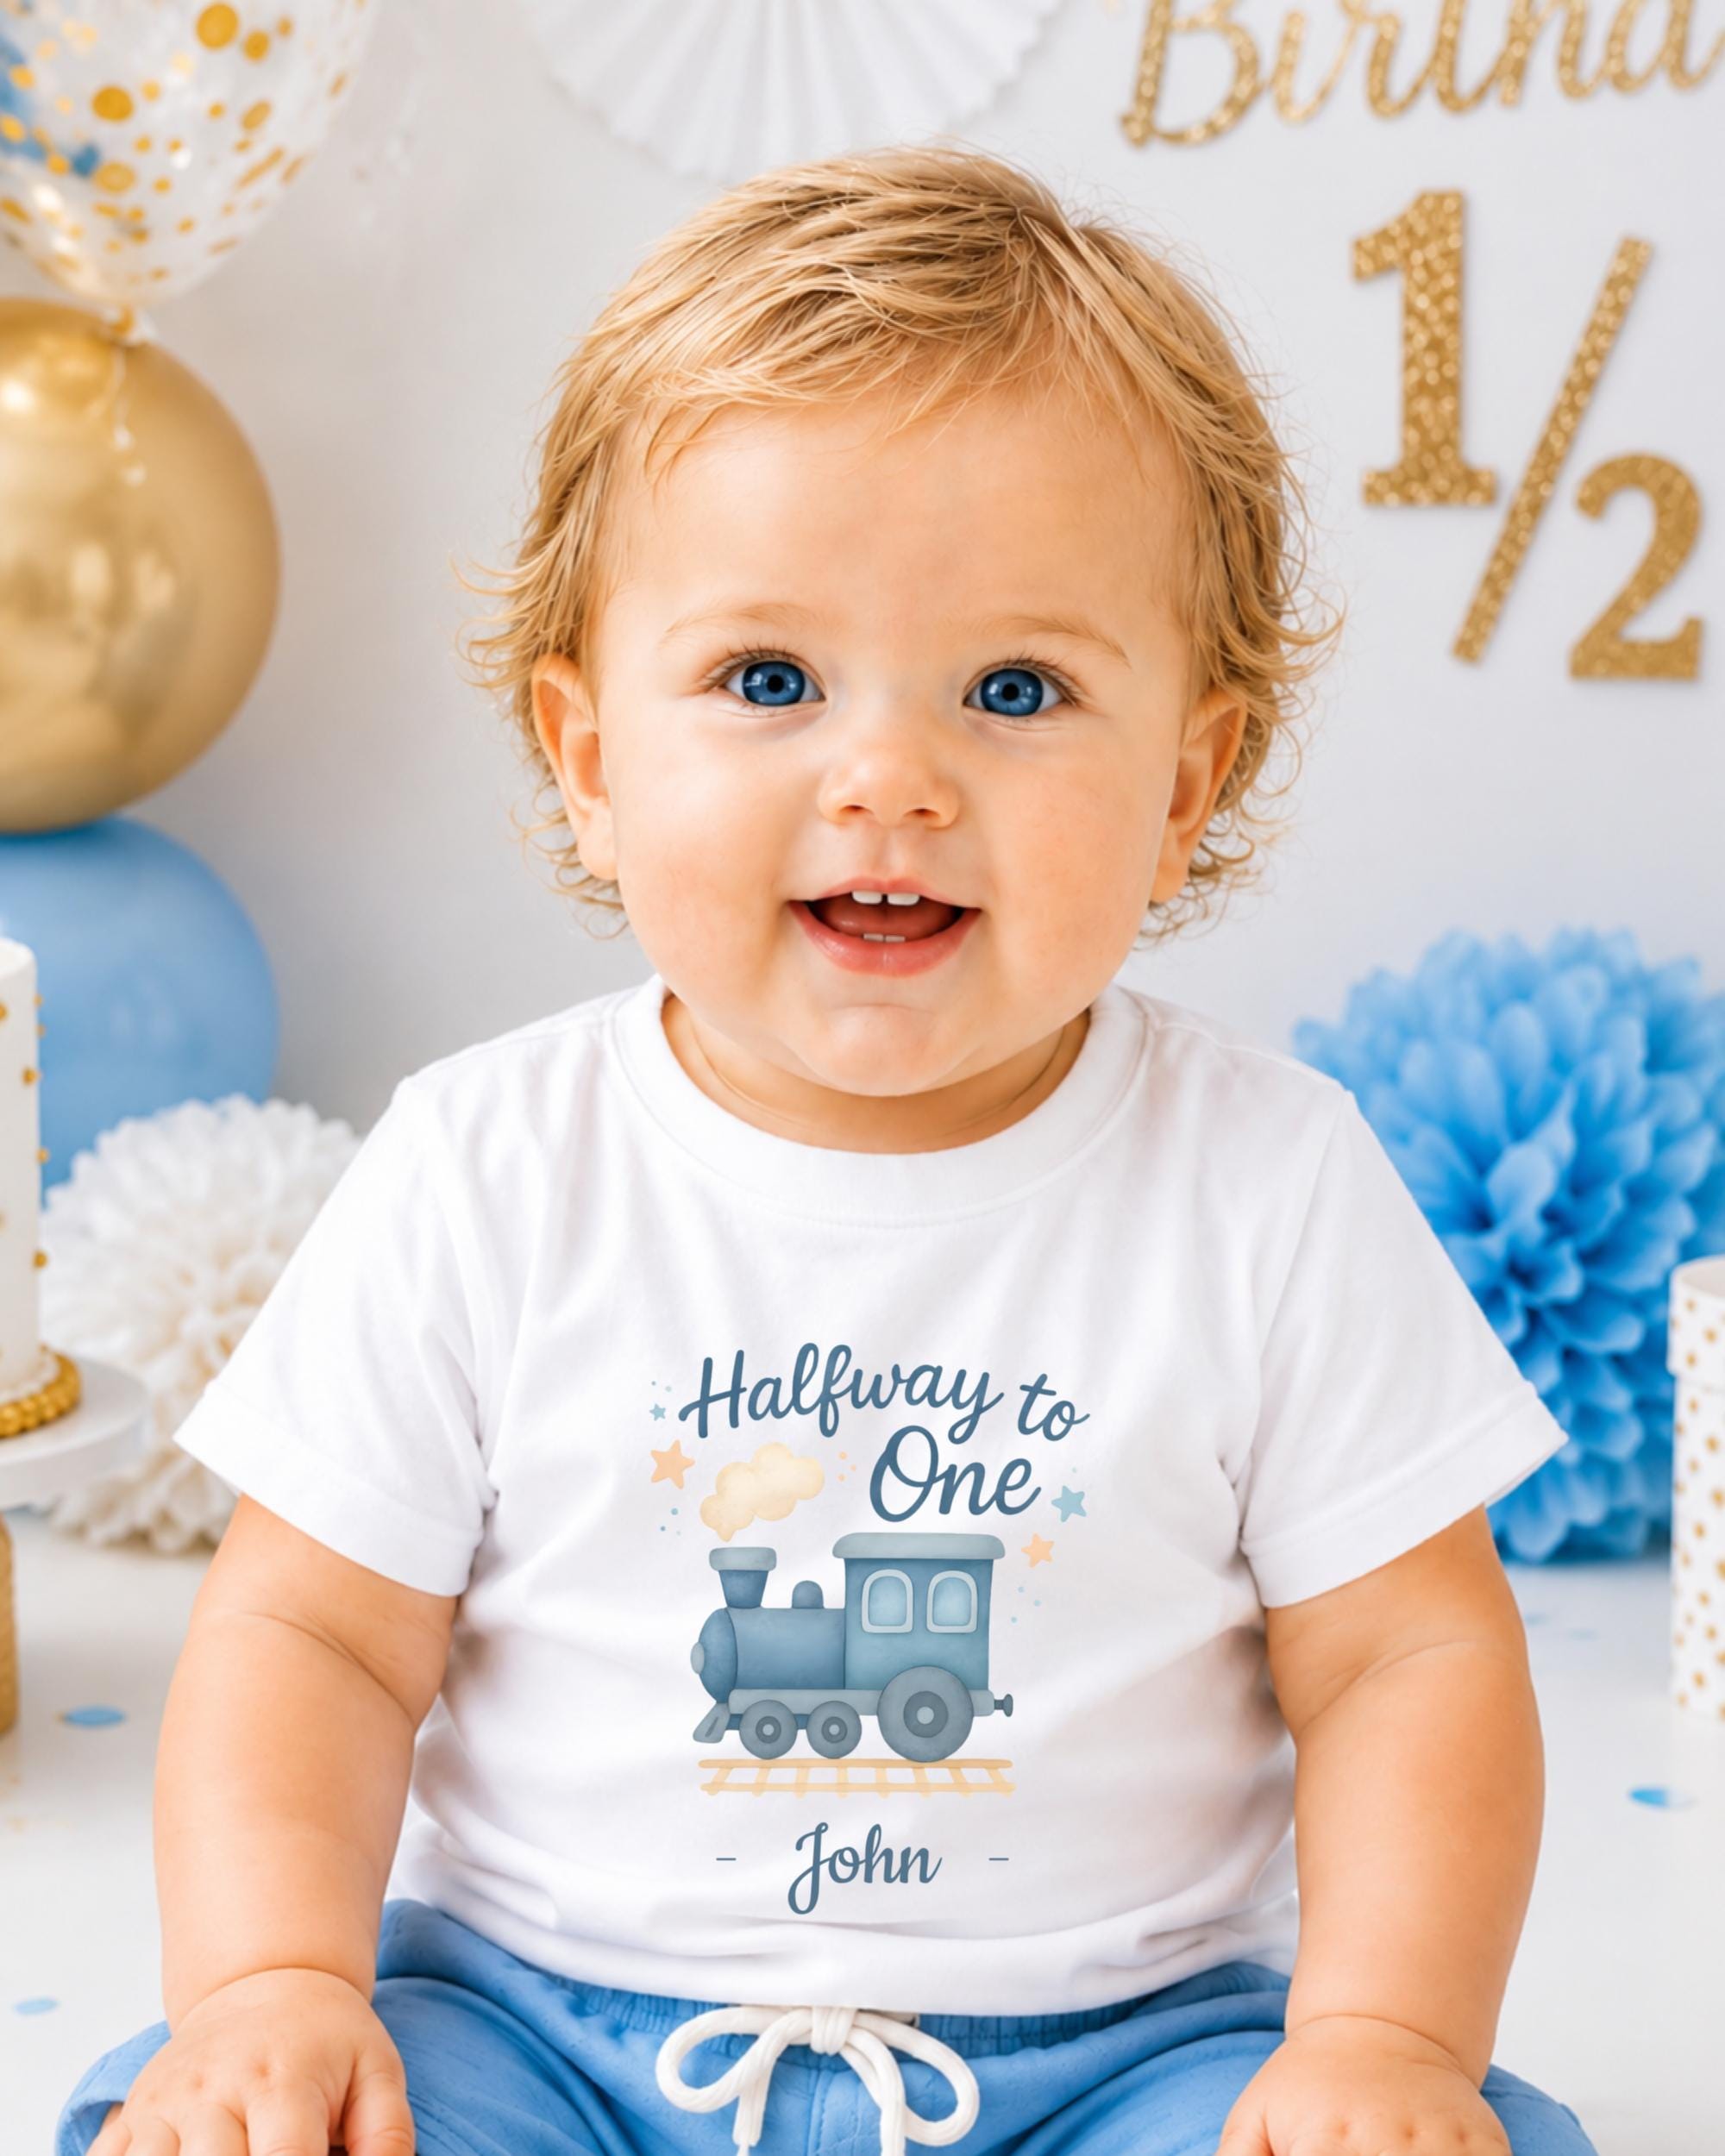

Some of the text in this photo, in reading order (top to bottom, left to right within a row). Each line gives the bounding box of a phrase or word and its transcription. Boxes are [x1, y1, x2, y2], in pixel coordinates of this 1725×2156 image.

[678, 1342, 1091, 1445] Halfway to
[869, 1425, 1042, 1523] One
[787, 1821, 943, 1915] John
